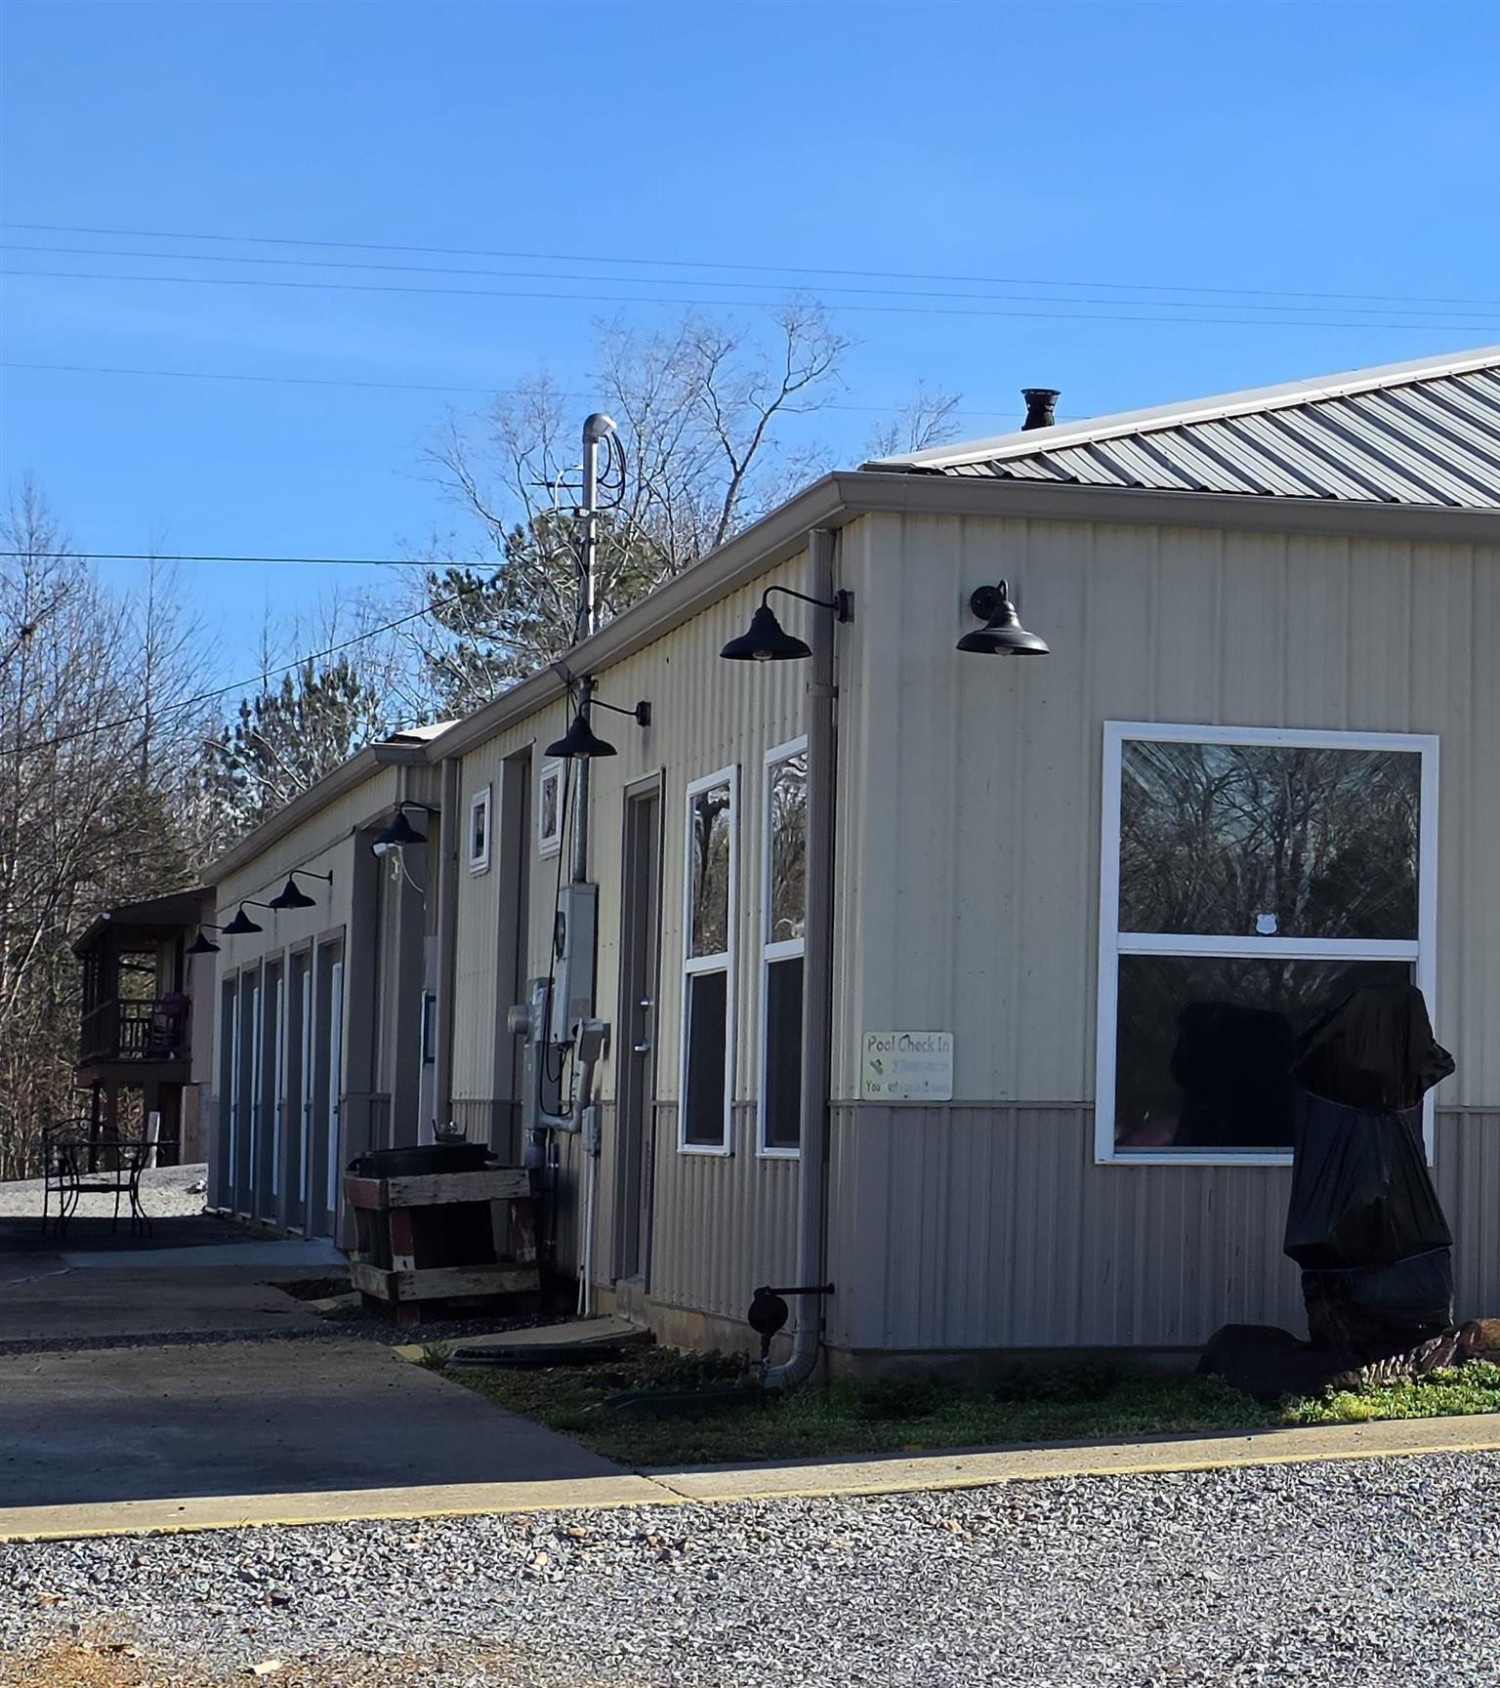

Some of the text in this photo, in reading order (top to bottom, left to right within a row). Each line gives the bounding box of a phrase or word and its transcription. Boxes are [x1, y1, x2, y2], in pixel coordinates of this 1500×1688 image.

[867, 1034, 950, 1053] Pool Check In
